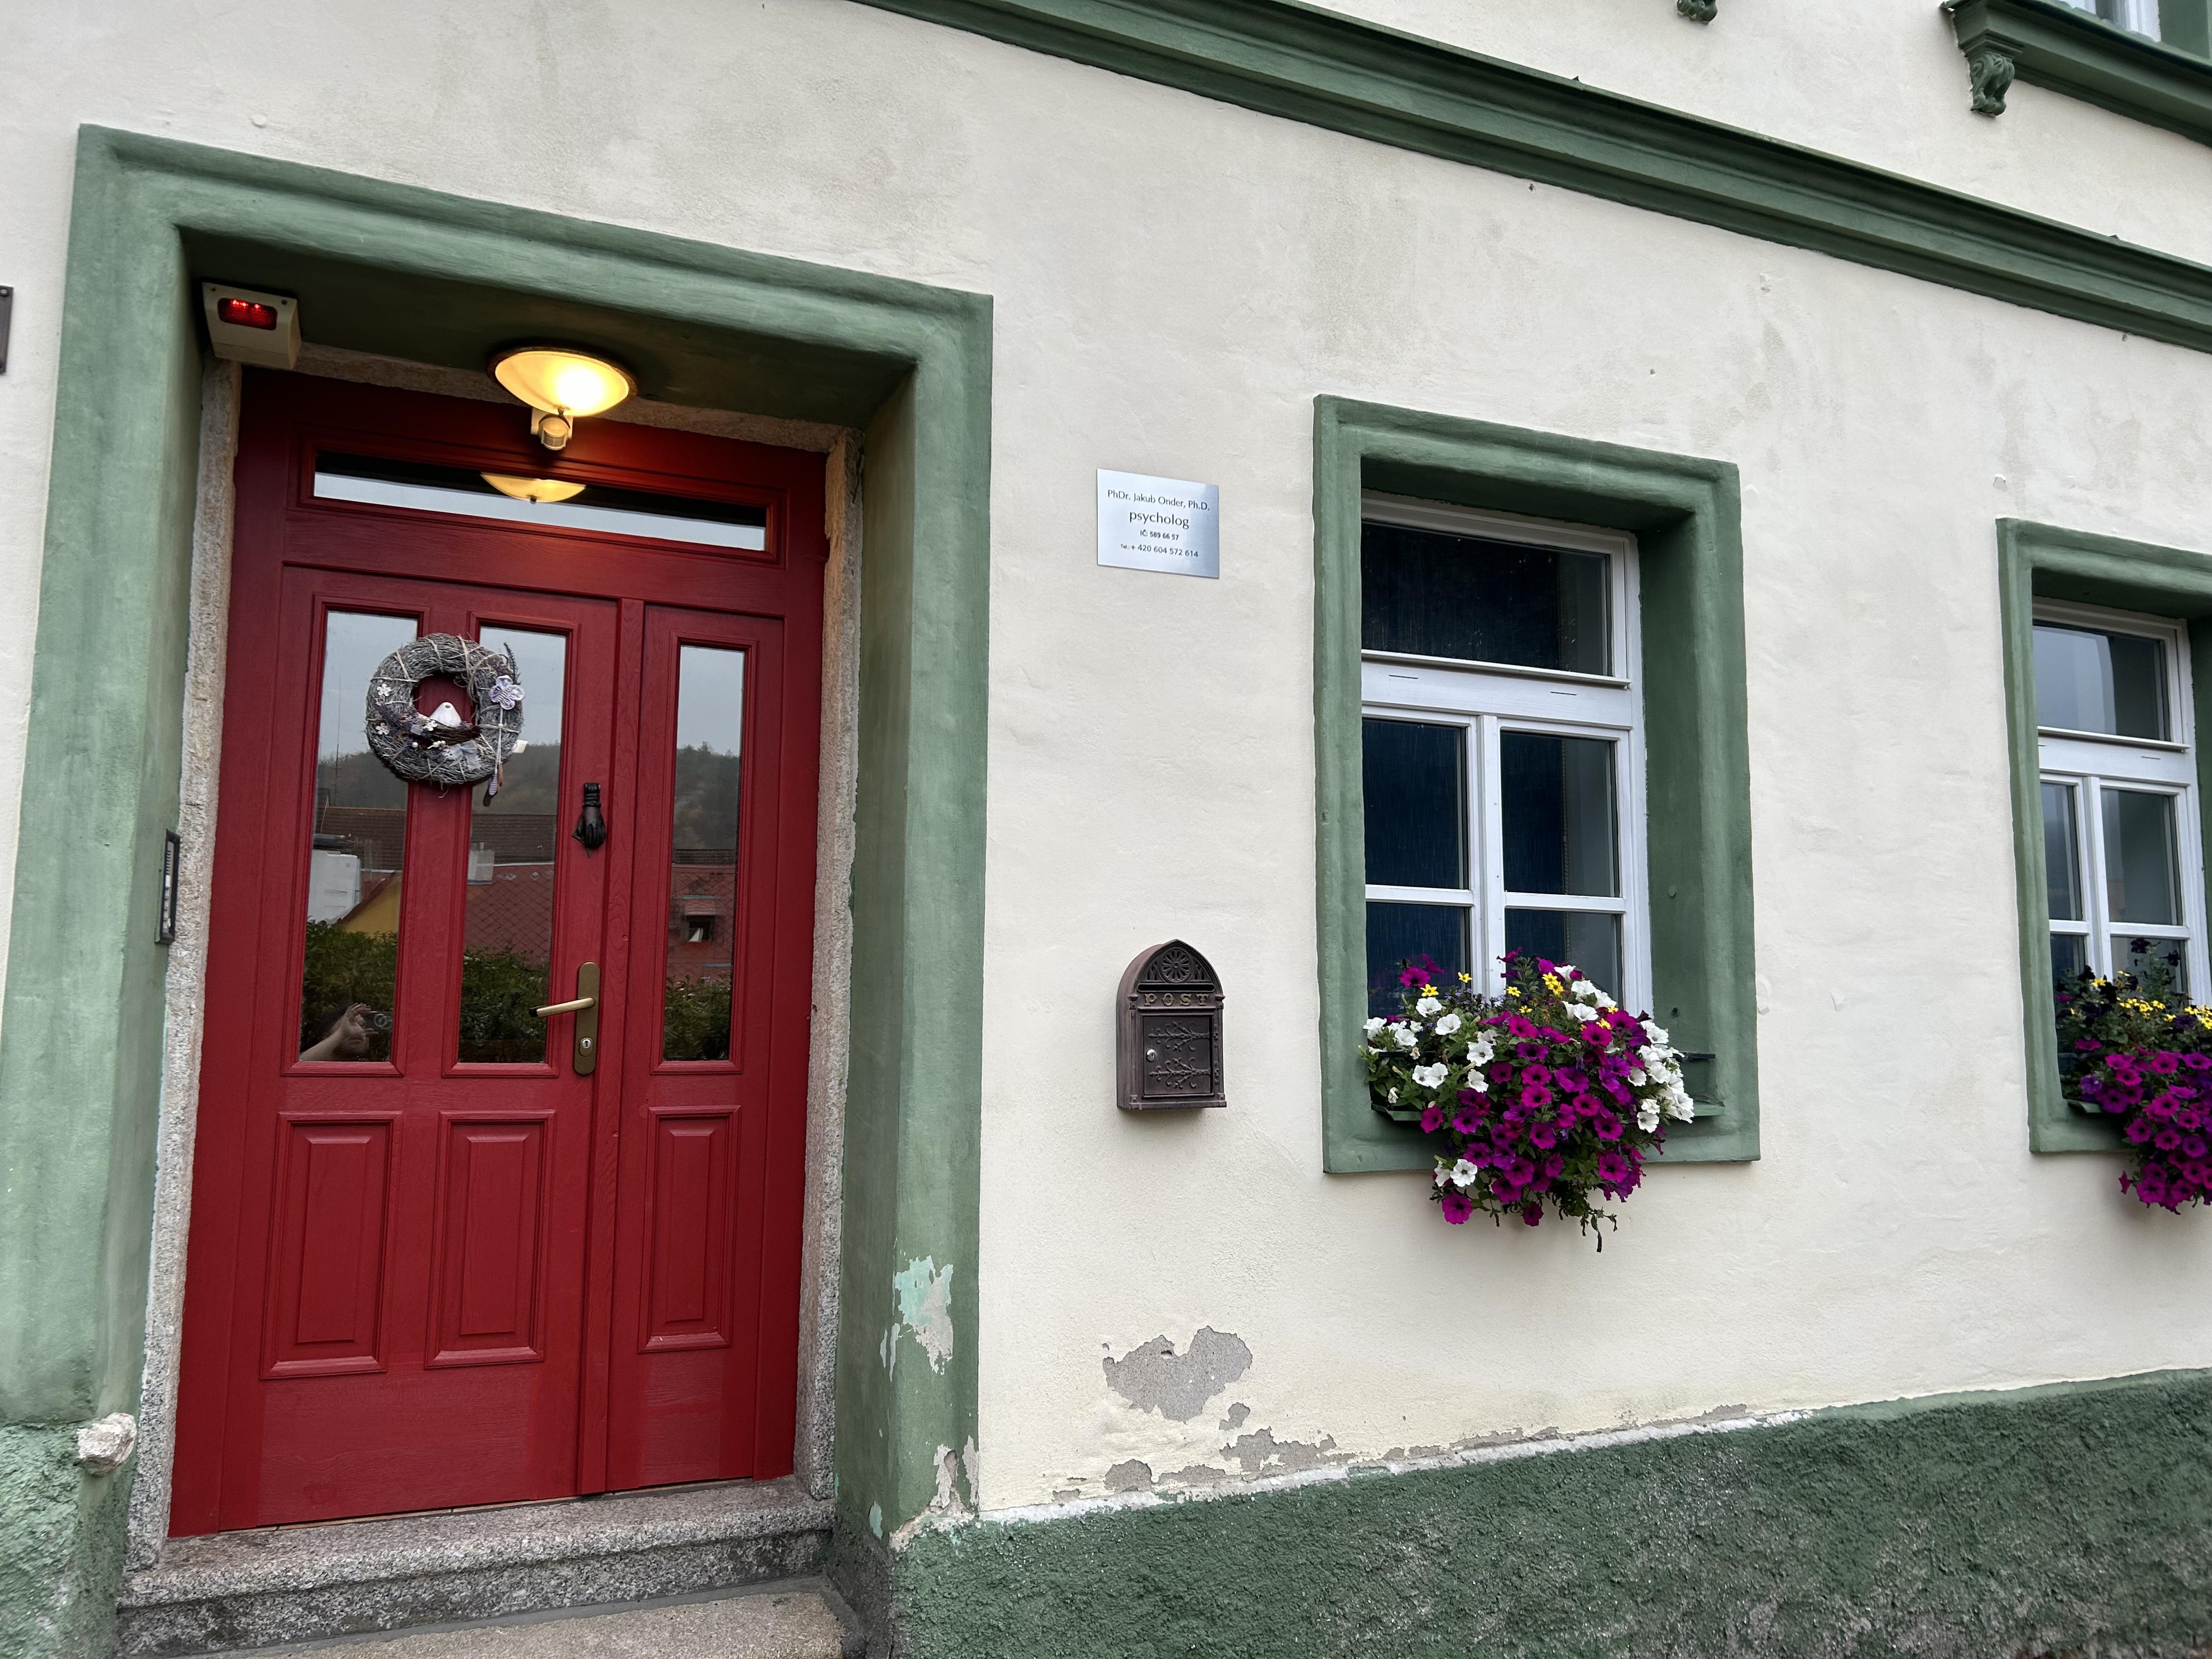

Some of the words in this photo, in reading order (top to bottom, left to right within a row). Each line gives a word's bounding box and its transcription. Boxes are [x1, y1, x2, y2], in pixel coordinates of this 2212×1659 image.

[1108, 489, 1131, 500] PhDr.
[1133, 493, 1156, 504] Jakub
[1158, 496, 1186, 509] Onder,
[1188, 500, 1210, 510] Ph.D.
[1129, 511, 1190, 530] psycholog
[1144, 993, 1210, 1006] POST
